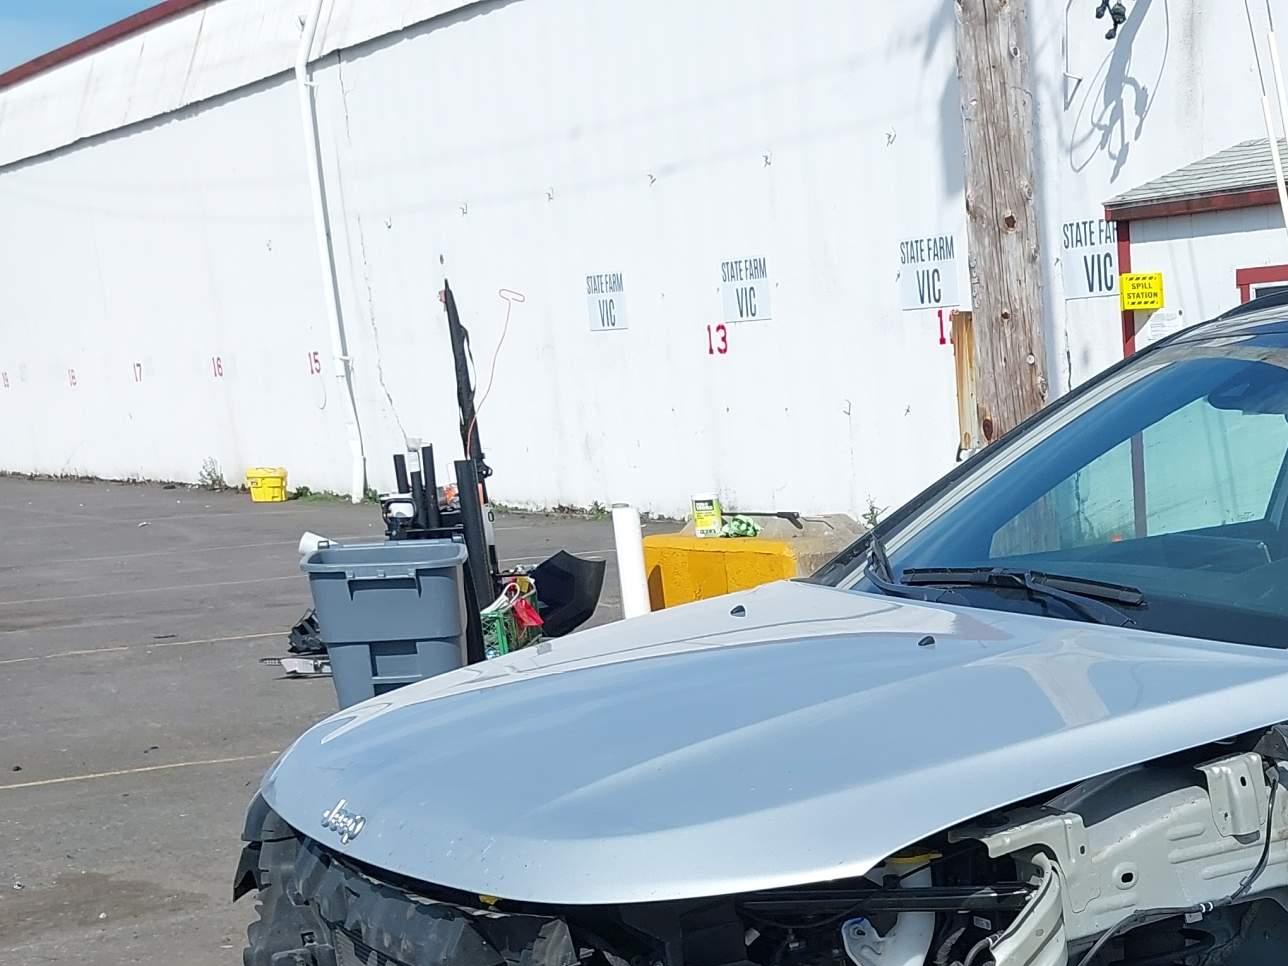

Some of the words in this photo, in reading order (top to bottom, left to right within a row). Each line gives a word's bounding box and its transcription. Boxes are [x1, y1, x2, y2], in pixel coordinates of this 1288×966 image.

[1063, 221, 1096, 249] STATE
[900, 239, 925, 265] STATE
[927, 235, 955, 261] FARM
[721, 260, 743, 282] STATE
[744, 257, 767, 280] FARM
[1083, 252, 1114, 293] VIC
[586, 275, 604, 295] STATE
[605, 273, 624, 293] FARM
[916, 268, 941, 304] VIC
[1126, 290, 1158, 301] STATION
[1131, 281, 1153, 291] SPILL
[598, 298, 616, 328] VIC
[736, 286, 757, 318] VIC
[706, 324, 729, 355] 13
[133, 362, 142, 382] 17
[212, 356, 224, 378] 16
[308, 351, 321, 375] 15
[321, 799, 366, 845] Jeep
